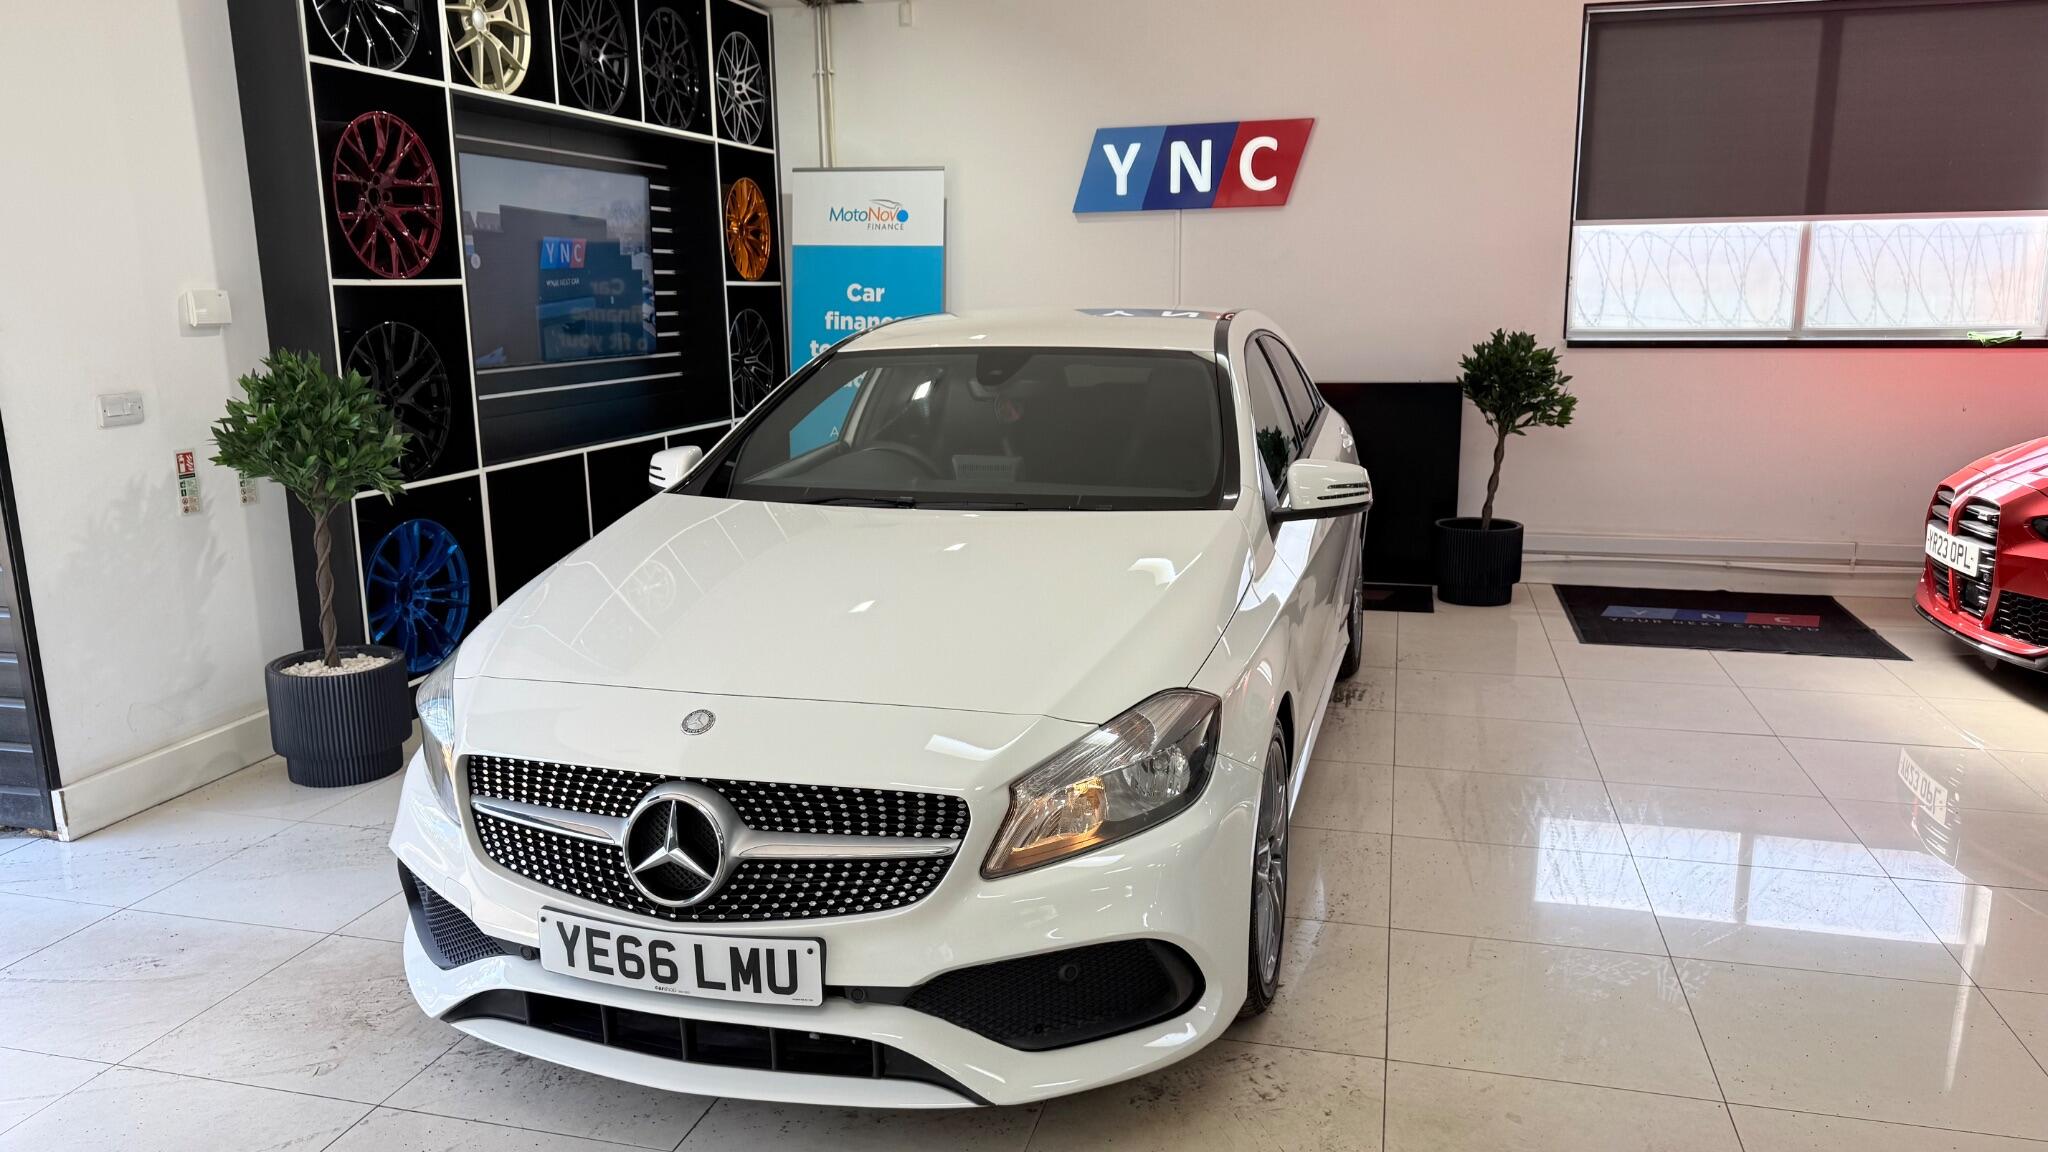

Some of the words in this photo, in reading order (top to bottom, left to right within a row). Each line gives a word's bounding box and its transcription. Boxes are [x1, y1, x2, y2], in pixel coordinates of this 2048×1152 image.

[1102, 135, 1279, 196] YNC
[867, 222, 904, 231] FINANCE
[546, 243, 582, 263] YNC
[847, 283, 885, 302] Car
[825, 311, 903, 331] finan
[1930, 529, 1949, 559] YR23
[556, 921, 679, 985] YE66
[693, 943, 798, 996] LMU
